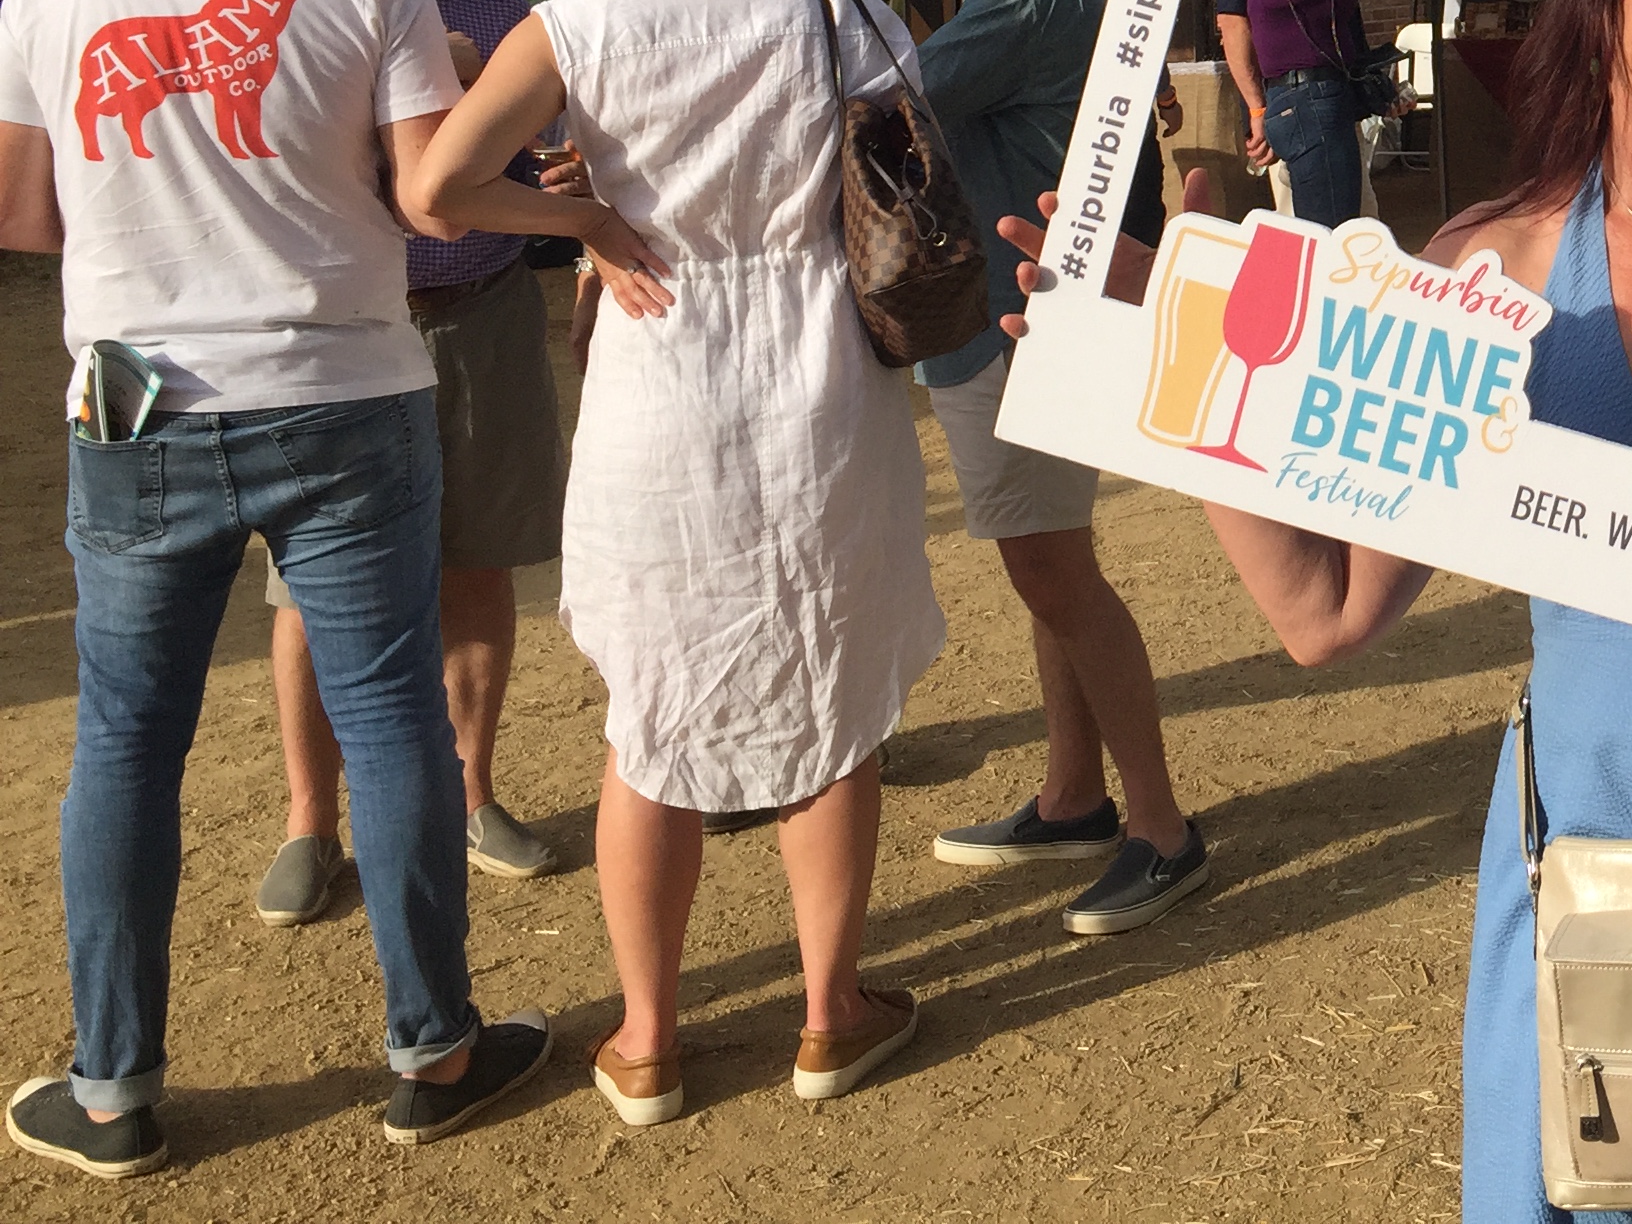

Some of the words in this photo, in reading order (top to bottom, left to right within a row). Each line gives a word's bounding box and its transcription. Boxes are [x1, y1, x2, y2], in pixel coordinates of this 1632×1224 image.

[174, 43, 272, 88] OUTDOOR
[229, 78, 261, 96] CO.
[1061, 97, 1130, 281] #sipurbia
[1329, 231, 1540, 331] Sipurbia
[1318, 297, 1521, 418] WINE
[1291, 374, 1469, 489] BEER
[1275, 451, 1414, 521] Festival
[1511, 486, 1587, 539] BEER.
